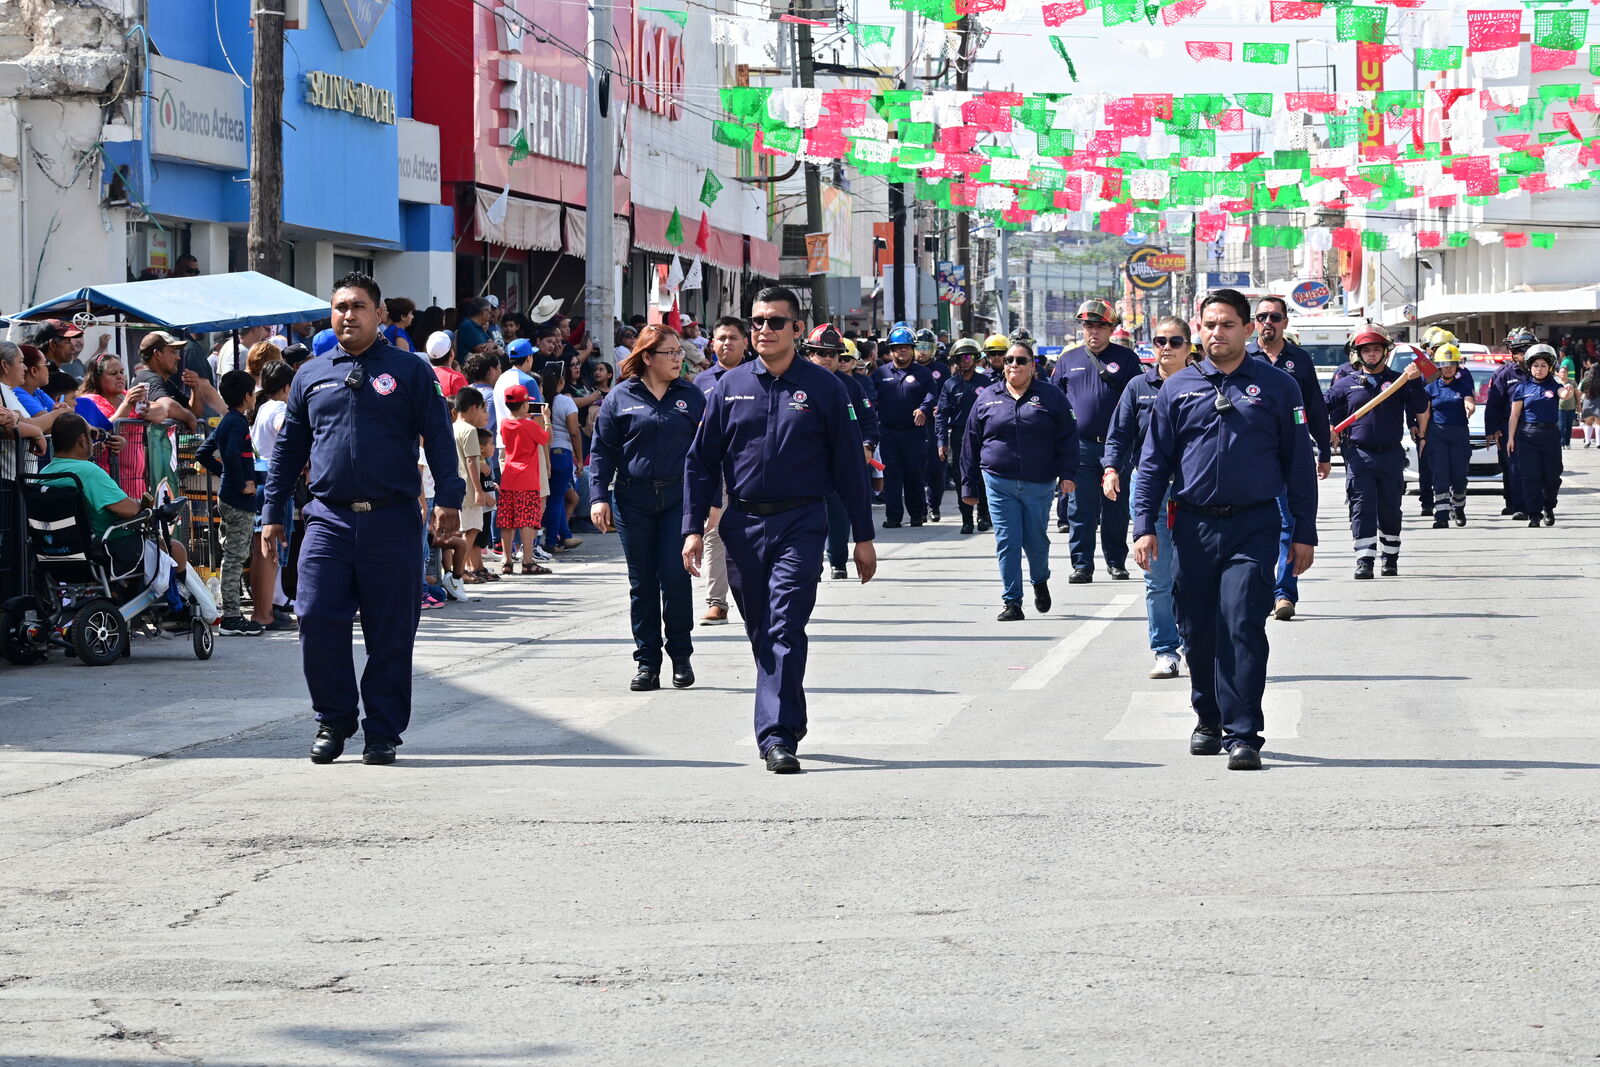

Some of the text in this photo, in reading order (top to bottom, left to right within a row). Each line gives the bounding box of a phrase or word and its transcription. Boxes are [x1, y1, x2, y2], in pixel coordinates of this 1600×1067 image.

[1468, 13, 1488, 21] VIVA
[310, 70, 355, 113] SALINAS
[361, 82, 397, 125] ROCHA
[179, 101, 244, 143] Banco Azteca
[412, 154, 438, 182] Azteca
[1293, 286, 1329, 304] VIAJEROS
